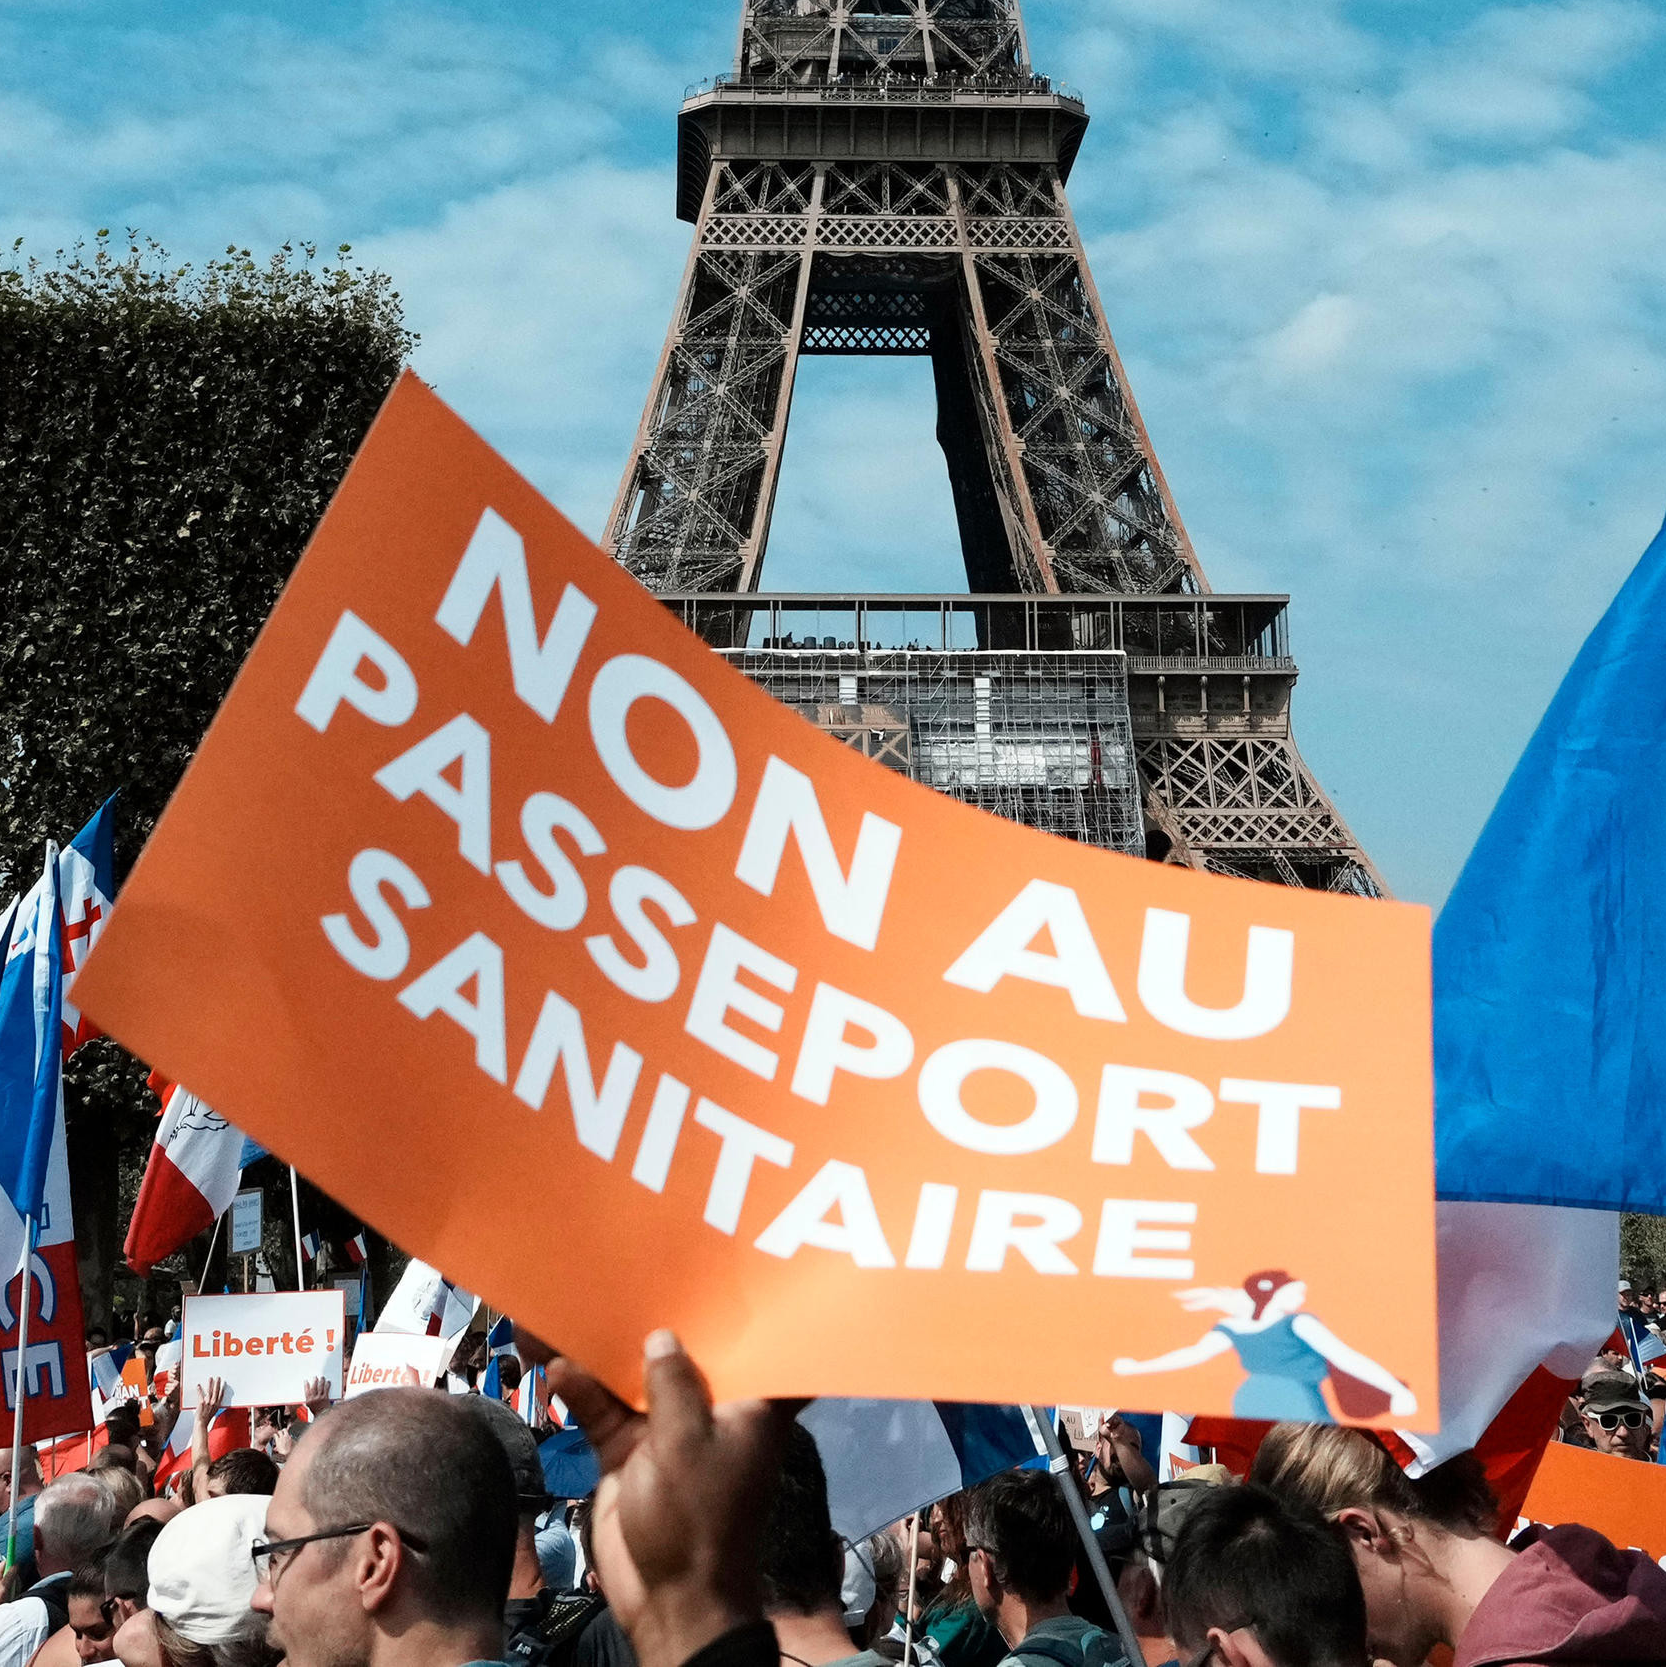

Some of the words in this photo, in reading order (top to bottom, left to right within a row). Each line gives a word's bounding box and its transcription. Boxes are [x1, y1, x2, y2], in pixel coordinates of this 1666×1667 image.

[295, 609, 1341, 1176] PASSEPORT
[435, 507, 903, 951] NON
[943, 877, 1295, 1040] AU
[320, 846, 1198, 1280] SANITAIRE
[193, 1328, 314, 1358] Liberté
[326, 1329, 335, 1352] !
